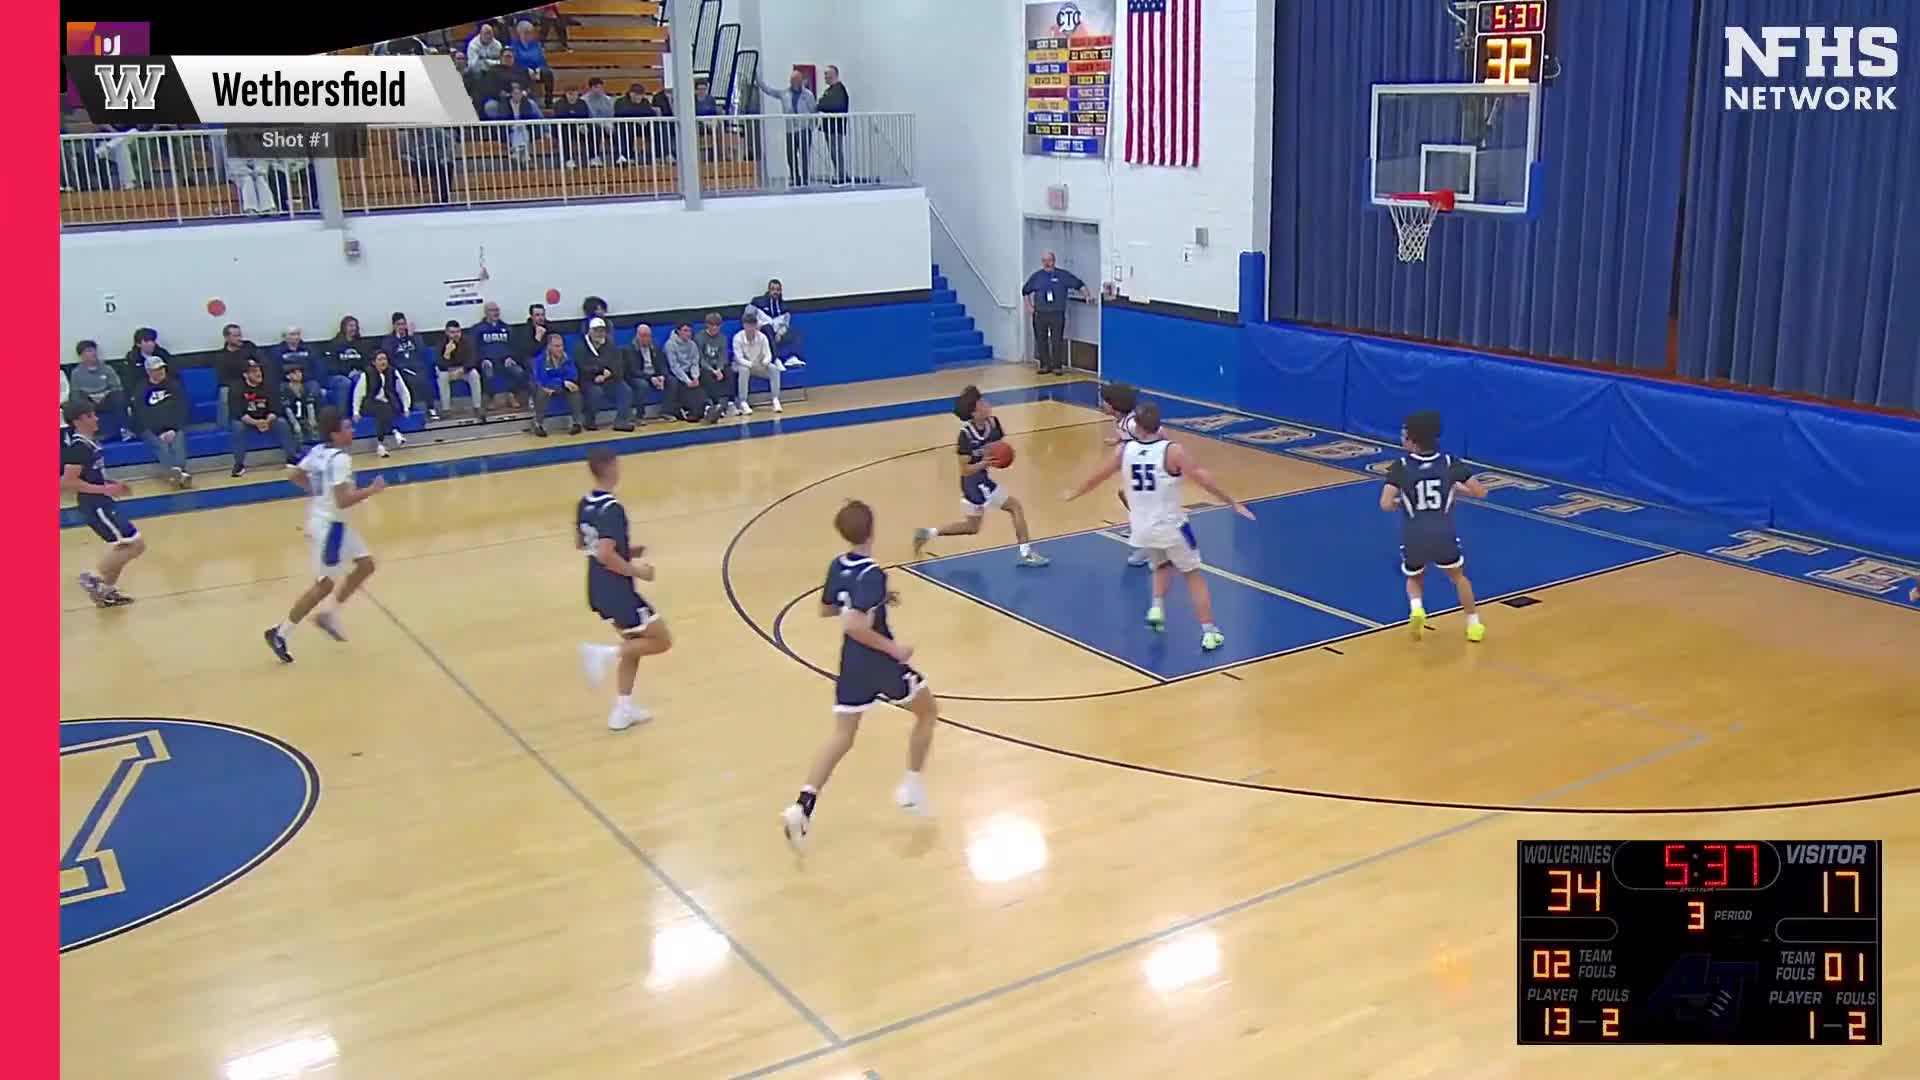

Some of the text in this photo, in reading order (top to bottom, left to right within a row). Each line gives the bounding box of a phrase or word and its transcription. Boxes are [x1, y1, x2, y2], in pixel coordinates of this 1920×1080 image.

[1056, 10, 1081, 27] CTC
[1494, 4, 1542, 30] 5:37
[1484, 38, 1531, 84] 32
[1131, 463, 1156, 491] 55
[1415, 479, 1441, 510] 15
[1524, 845, 1611, 864] WOLVERINES
[1664, 844, 1760, 886] 5:37
[1786, 845, 1866, 865] VISITOR
[1547, 870, 1601, 912] 34
[1822, 871, 1860, 913] 17
[1687, 901, 1752, 930] 3 PERIOD
[1533, 950, 1570, 978] 02
[1579, 949, 1612, 963] TEAM
[1780, 951, 1815, 965] TEAM
[1824, 952, 1864, 981] 01
[1578, 965, 1616, 979] FOULS
[1776, 967, 1815, 981] FOULS
[1527, 988, 1629, 1003] PLAYER FOULS
[1769, 991, 1876, 1006] PLAYER FOULS
[1543, 1007, 1620, 1036] 13 2
[1847, 1011, 1866, 1040] 2
